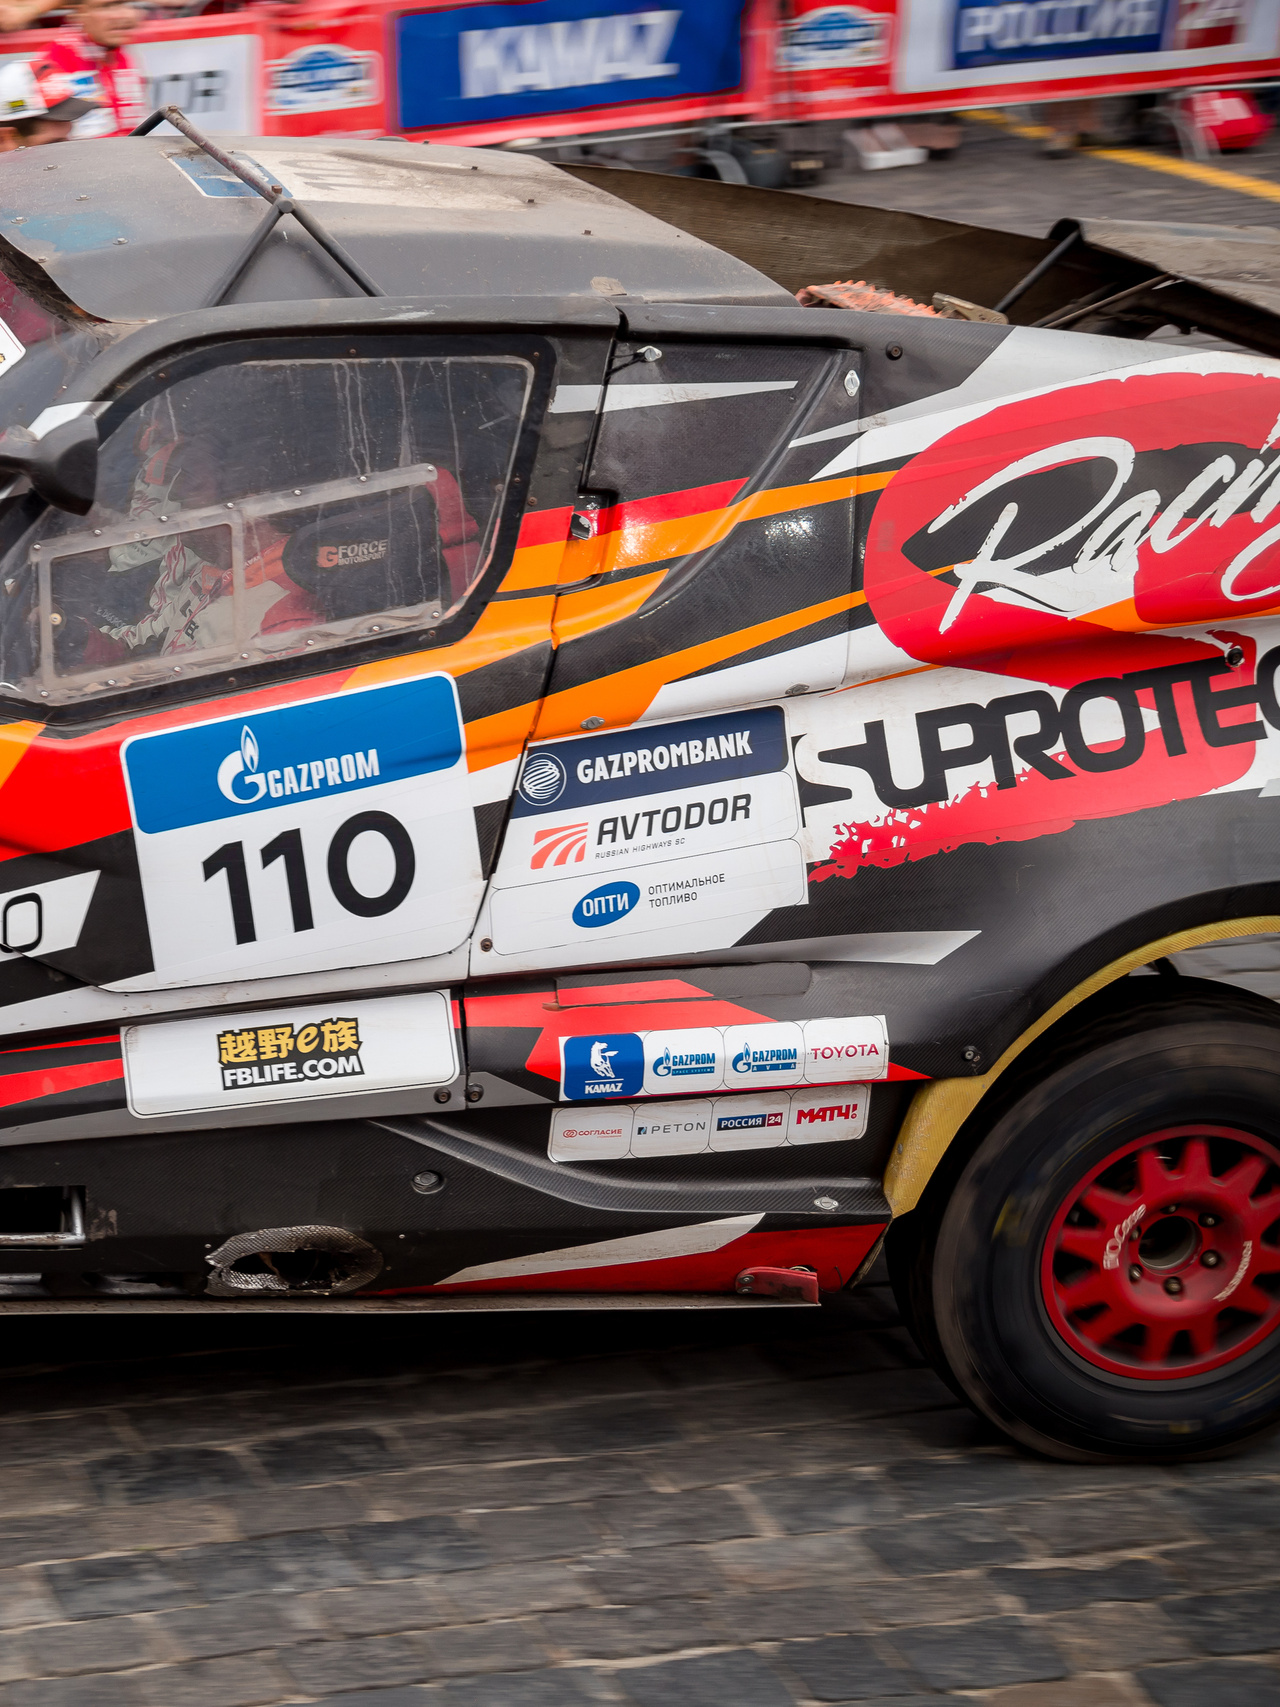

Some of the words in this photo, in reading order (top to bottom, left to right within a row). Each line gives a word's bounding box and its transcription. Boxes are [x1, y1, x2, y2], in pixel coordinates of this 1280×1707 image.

[577, 730, 753, 784] GAZPROMBANK
[267, 748, 380, 798] GAZPROM
[597, 793, 752, 846] AVTODOR
[595, 848, 629, 859] RUSSIAN
[632, 840, 672, 852] HIGHWAYS
[675, 837, 686, 846] SC
[201, 809, 416, 946] 110
[648, 873, 725, 895] ОПТИМАЛЬНОЕ
[582, 892, 629, 917] ОПТИ
[649, 892, 698, 908] ТОПЛИВО
[219, 1020, 360, 1065] 越野e族
[811, 1043, 879, 1060] TOYOTA
[672, 1053, 715, 1067] GAZPROM
[752, 1048, 797, 1063] GAZPROM
[224, 1055, 361, 1087] FBLIFE.COM
[584, 1082, 624, 1094] KAMAZ
[721, 1117, 762, 1128] РОССИЯ
[768, 1115, 782, 1124] 24
[796, 1104, 858, 1125] МАТЧ!
[651, 1122, 706, 1134] PETON
